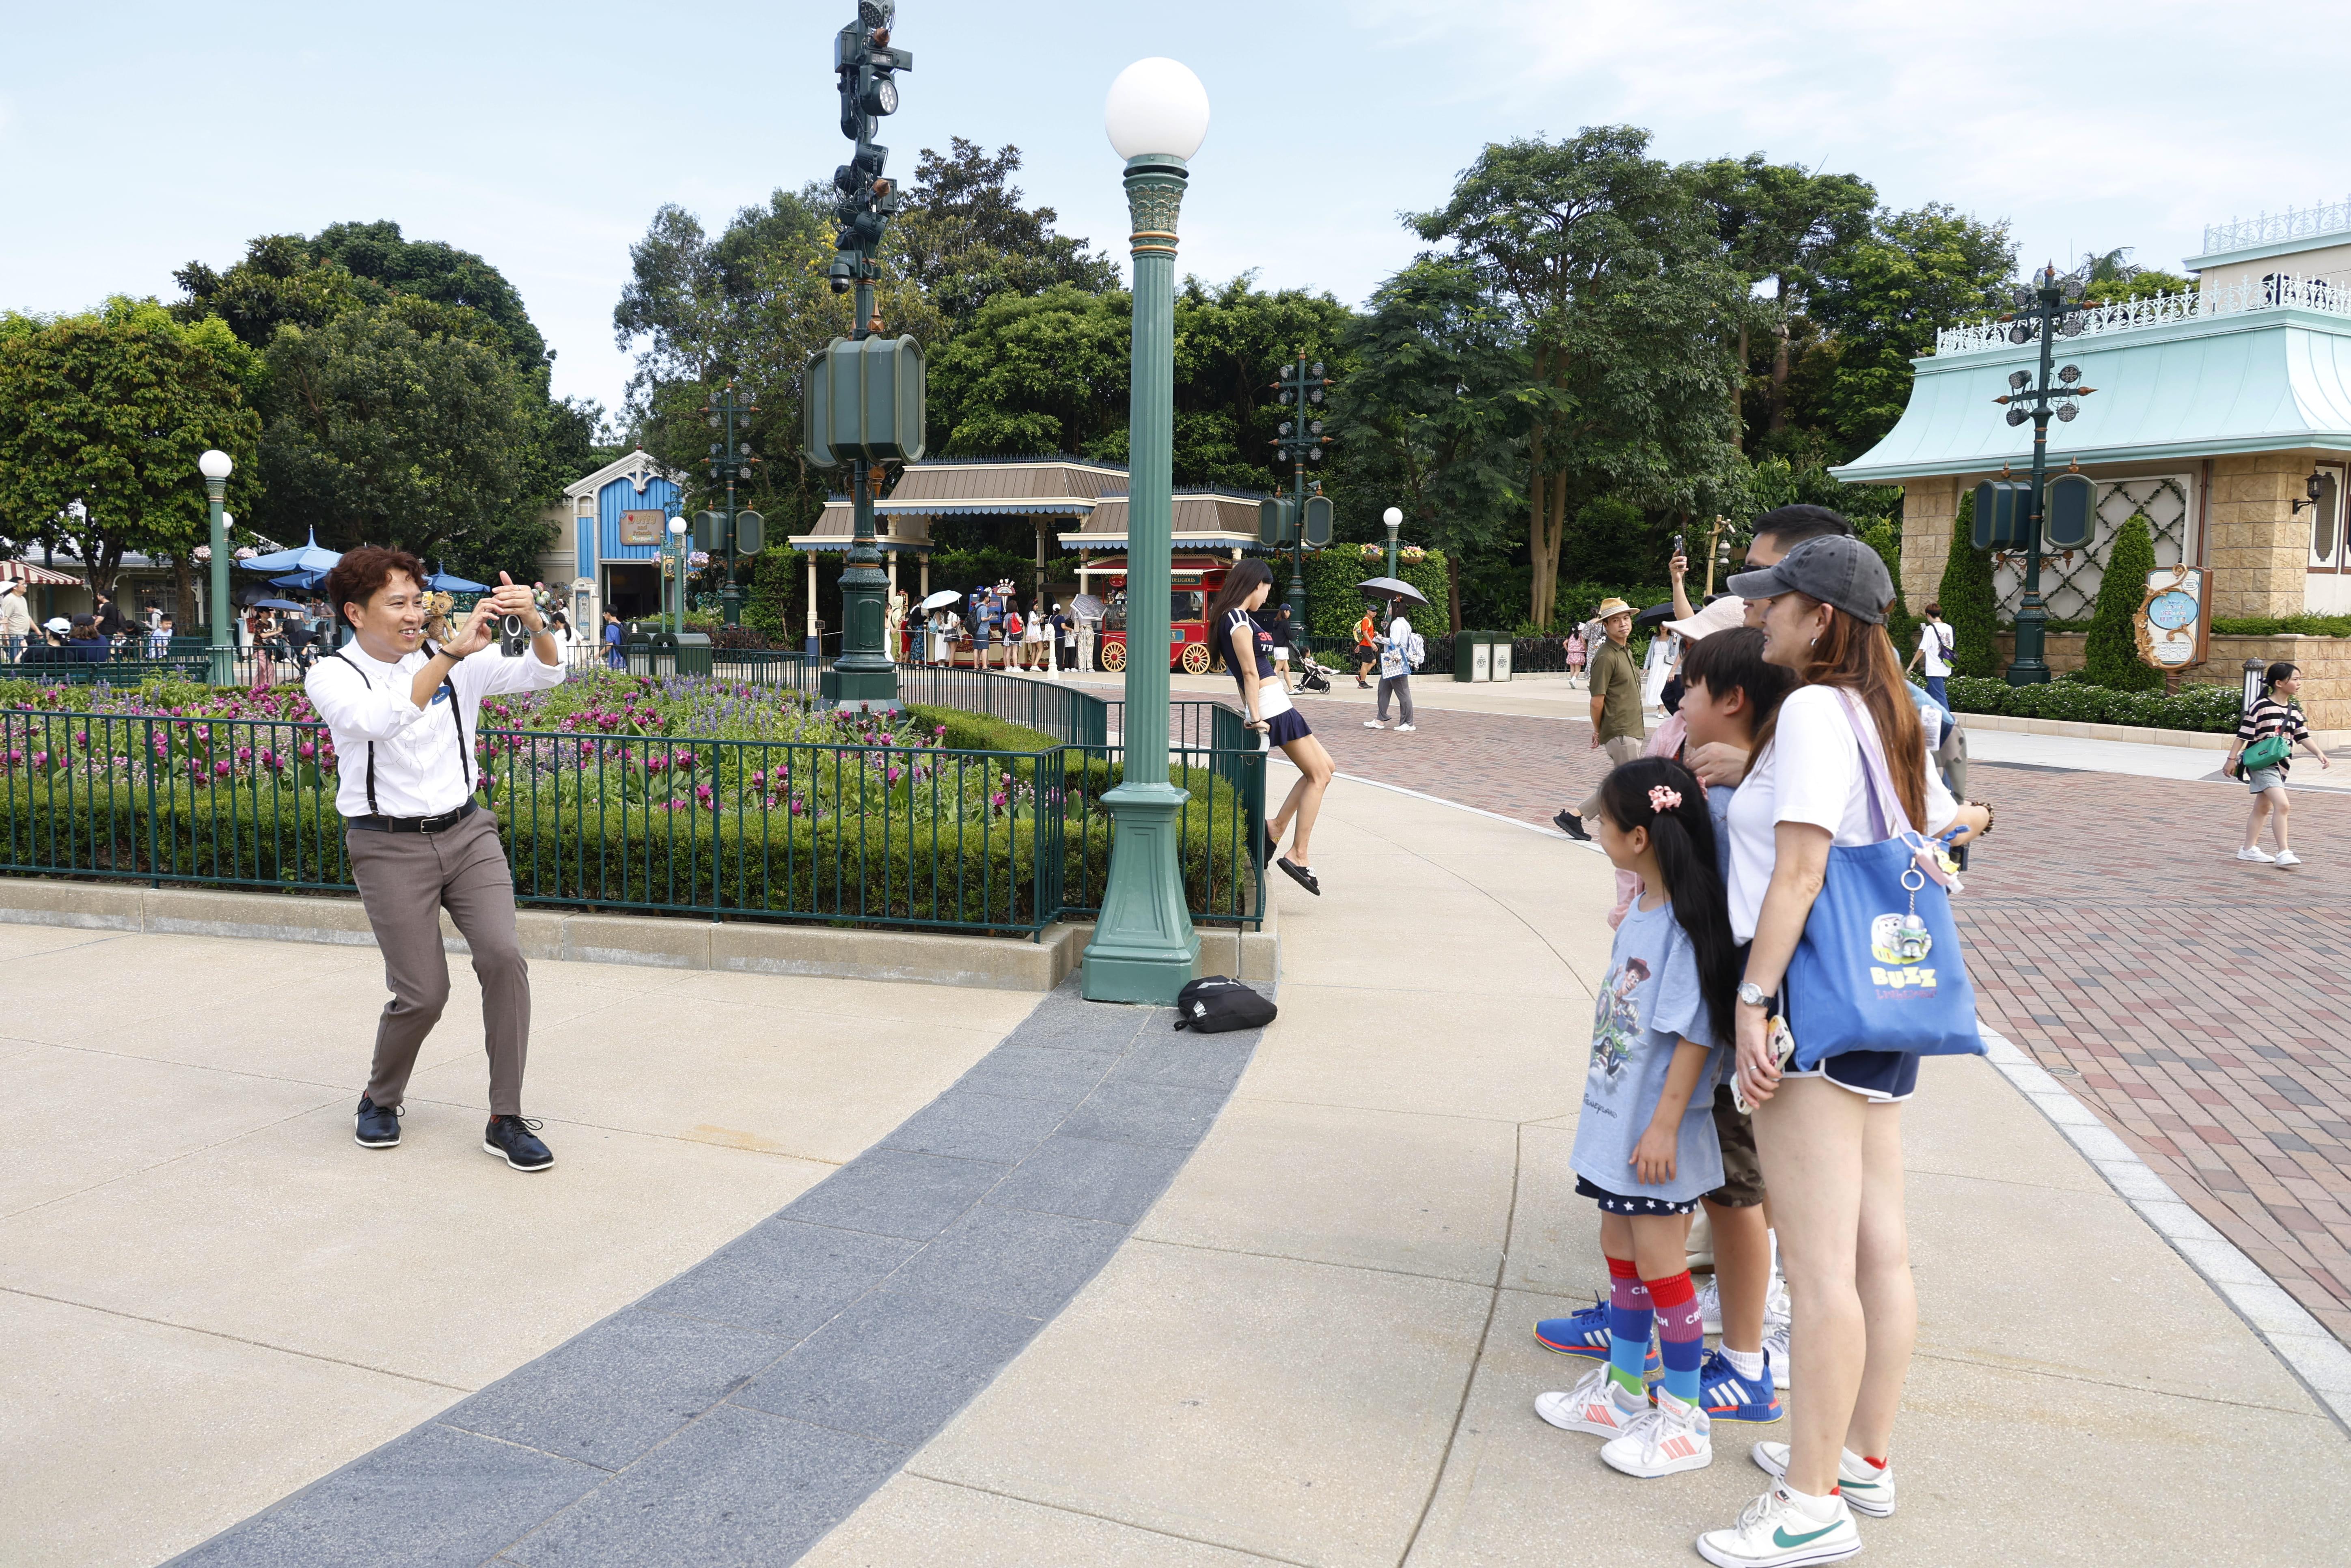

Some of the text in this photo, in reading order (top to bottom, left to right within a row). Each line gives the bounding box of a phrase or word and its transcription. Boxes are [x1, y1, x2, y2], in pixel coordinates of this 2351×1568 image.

[627, 513, 656, 525] Duffy
[1870, 966, 1937, 989] BUZZ
[1659, 1396, 1682, 1415] adidas
[1779, 1489, 1790, 1501] NIKE
